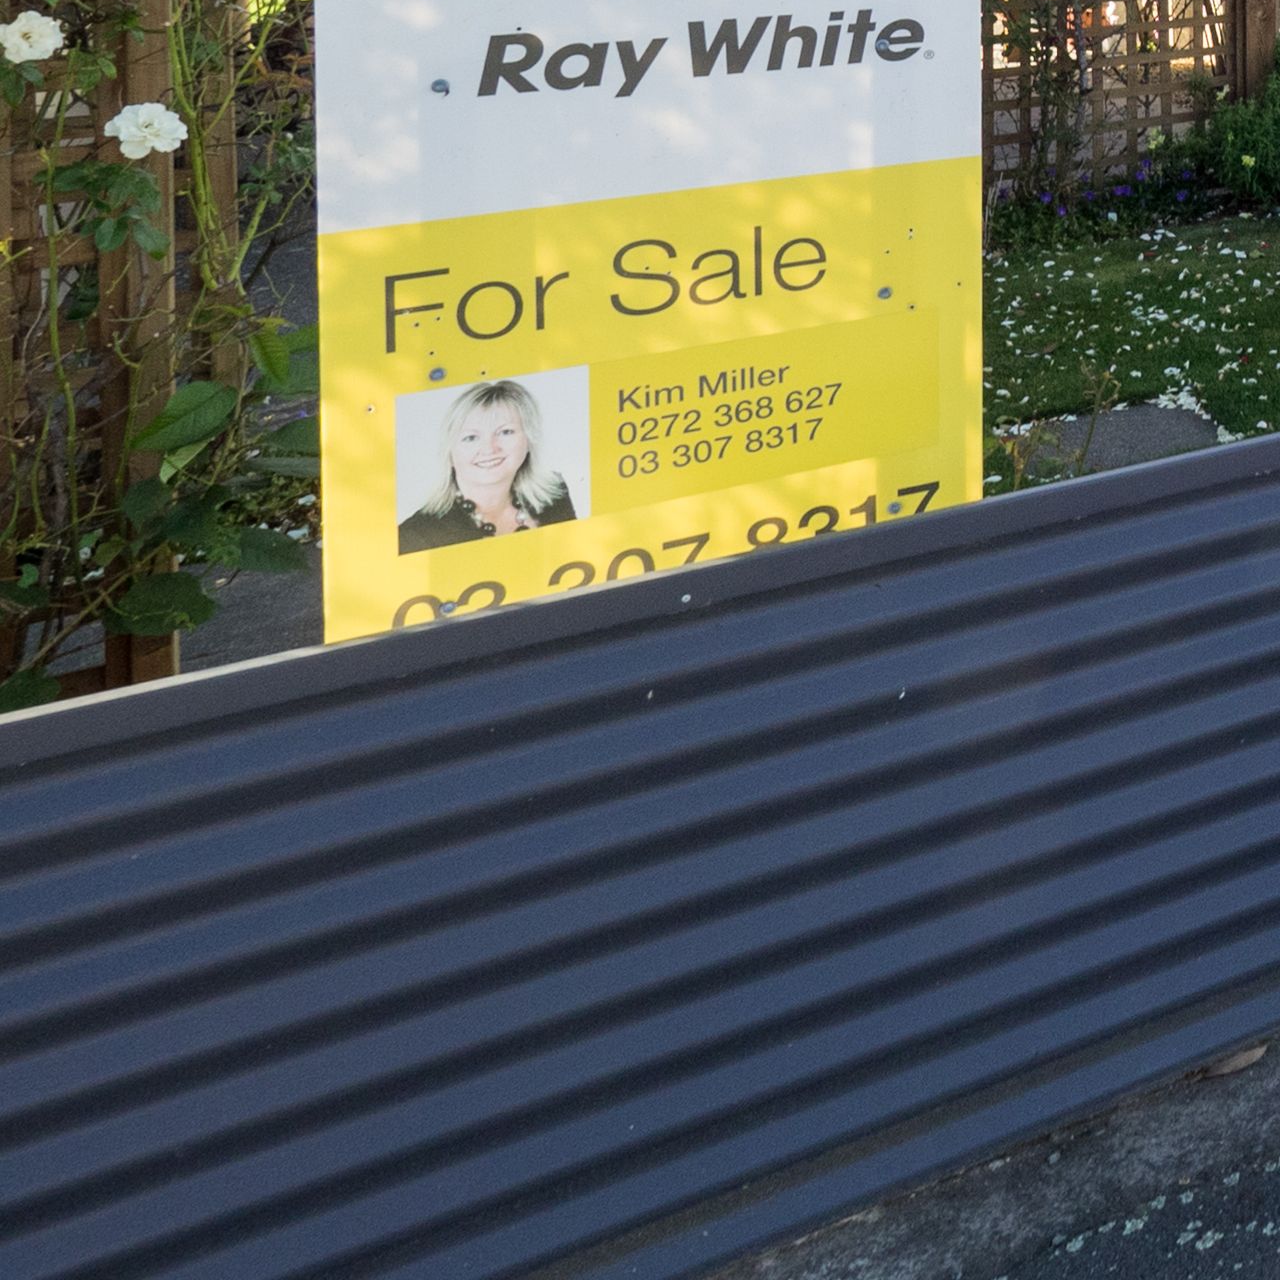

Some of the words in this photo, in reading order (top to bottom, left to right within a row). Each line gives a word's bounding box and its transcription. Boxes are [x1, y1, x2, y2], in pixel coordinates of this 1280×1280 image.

[476, 31, 669, 98] Ray
[687, 8, 925, 78] White
[384, 267, 571, 355] For
[609, 225, 827, 317] Sale
[617, 384, 685, 413] Kim
[698, 365, 790, 399] Miller
[617, 409, 702, 446] 0272
[713, 395, 774, 428] 368
[785, 382, 843, 414] 627
[617, 449, 660, 479] 03
[671, 435, 733, 469] 307
[744, 417, 824, 453] 8317
